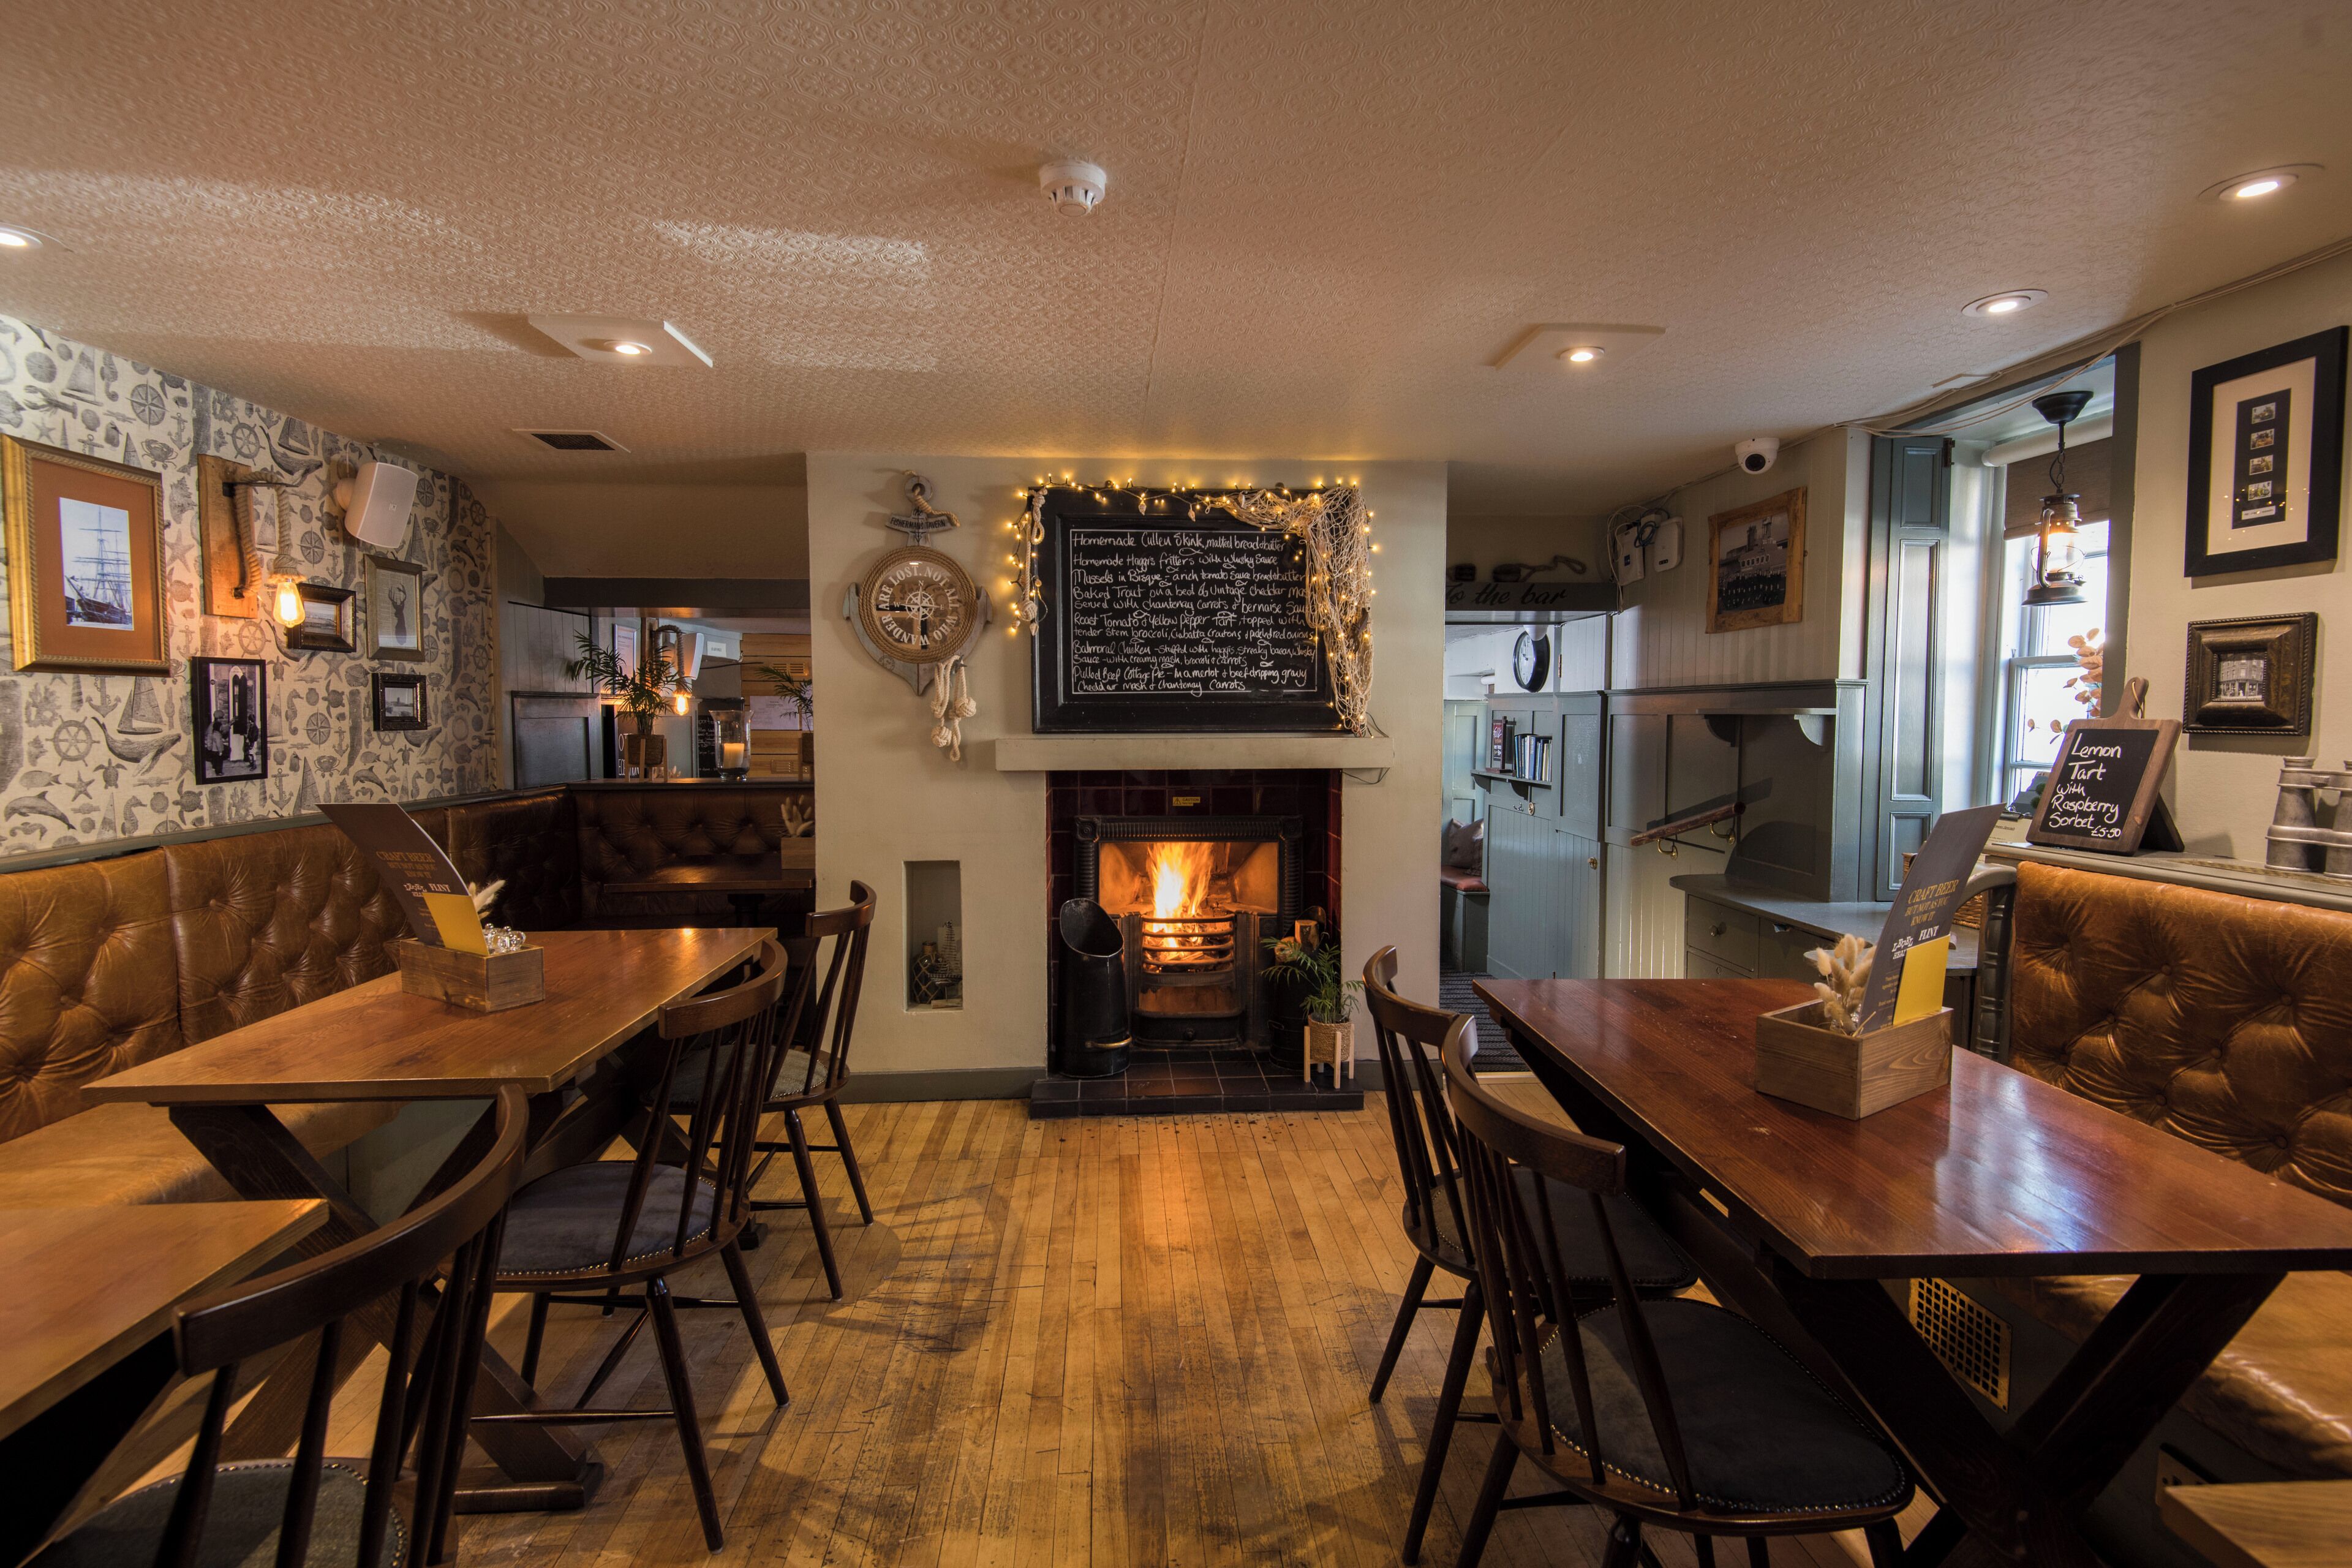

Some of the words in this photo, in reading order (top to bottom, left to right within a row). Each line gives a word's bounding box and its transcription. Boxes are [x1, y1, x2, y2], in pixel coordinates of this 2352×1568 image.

[925, 519, 945, 530] TAVERN
[1072, 532, 1137, 547] Homemade
[1141, 532, 1172, 547] Cullen
[1207, 535, 1232, 549] malted
[1234, 535, 1259, 550] bread
[1264, 535, 1286, 552] butter
[1073, 552, 1123, 567] Homemade
[1127, 553, 1156, 573] Haggis
[1159, 552, 1195, 569] fritters
[1199, 553, 1222, 565] with
[1255, 553, 1278, 565] Sauce
[888, 565, 922, 586] LOST.
[925, 567, 949, 586] NOT
[1071, 568, 1114, 586] Mussels
[1118, 571, 1127, 582] in
[1127, 569, 1163, 587] Bisque
[1180, 569, 1199, 582] rich
[1200, 568, 1229, 581] tomato
[1253, 568, 1272, 581] bread
[1276, 567, 1306, 581] butter
[878, 584, 894, 611] ARE
[944, 587, 960, 610] ALL
[1073, 586, 1110, 600] Baked
[1112, 584, 1146, 598] Trout
[1149, 589, 1164, 598] on
[1175, 583, 1195, 595] bed
[1209, 584, 1248, 603] Vintage
[1470, 582, 1510, 606] the
[1520, 582, 1568, 605] bar
[1114, 598, 1139, 609] with
[1196, 597, 1229, 609] Carrots
[1242, 597, 1282, 613] bernaise
[881, 613, 930, 646] WANDER
[933, 615, 958, 641] WHO
[1074, 612, 1099, 625] Roast
[1100, 612, 1139, 627] Tomato
[1148, 614, 1178, 629] Yellow
[1241, 615, 1274, 628] topped
[1278, 614, 1306, 627] with
[1073, 626, 1104, 637] tender
[1170, 627, 1205, 640] Ciabatta
[1249, 628, 1273, 642] pickled
[1272, 627, 1287, 639] red
[1286, 628, 1314, 640] onions
[1072, 639, 1117, 654] Balmoral
[1117, 641, 1151, 655] Chicken
[1189, 644, 1208, 654] with
[1237, 646, 1268, 660] streaky
[1072, 654, 1100, 665] Sauce
[1184, 655, 1210, 665] broccoli
[1072, 665, 1101, 682] Pulled
[1102, 667, 1121, 683] Beef
[1123, 666, 1152, 684] Cottage
[1151, 666, 1166, 683] Pie
[1193, 667, 1220, 678] merlot
[1248, 666, 1280, 684] dripping
[1281, 669, 1307, 687] gravy
[1208, 679, 1246, 691] Carrots
[2071, 733, 2122, 759] Lemon
[2068, 760, 2106, 781] Tart
[2056, 781, 2086, 796] with
[2051, 794, 2119, 824] Raspberry
[2048, 812, 2095, 829] Sorbet
[375, 851, 408, 861] CRAFT
[405, 852, 436, 862] BEER
[428, 883, 451, 892] FLINT
[1908, 884, 1938, 904] CRAFT
[1935, 879, 1959, 897] BEER
[1904, 905, 1917, 917] BUT
[1916, 901, 1932, 913] NOT
[1910, 912, 1929, 926] KNOW
[1928, 911, 1936, 922] IT
[1918, 925, 1940, 941] FLINT
